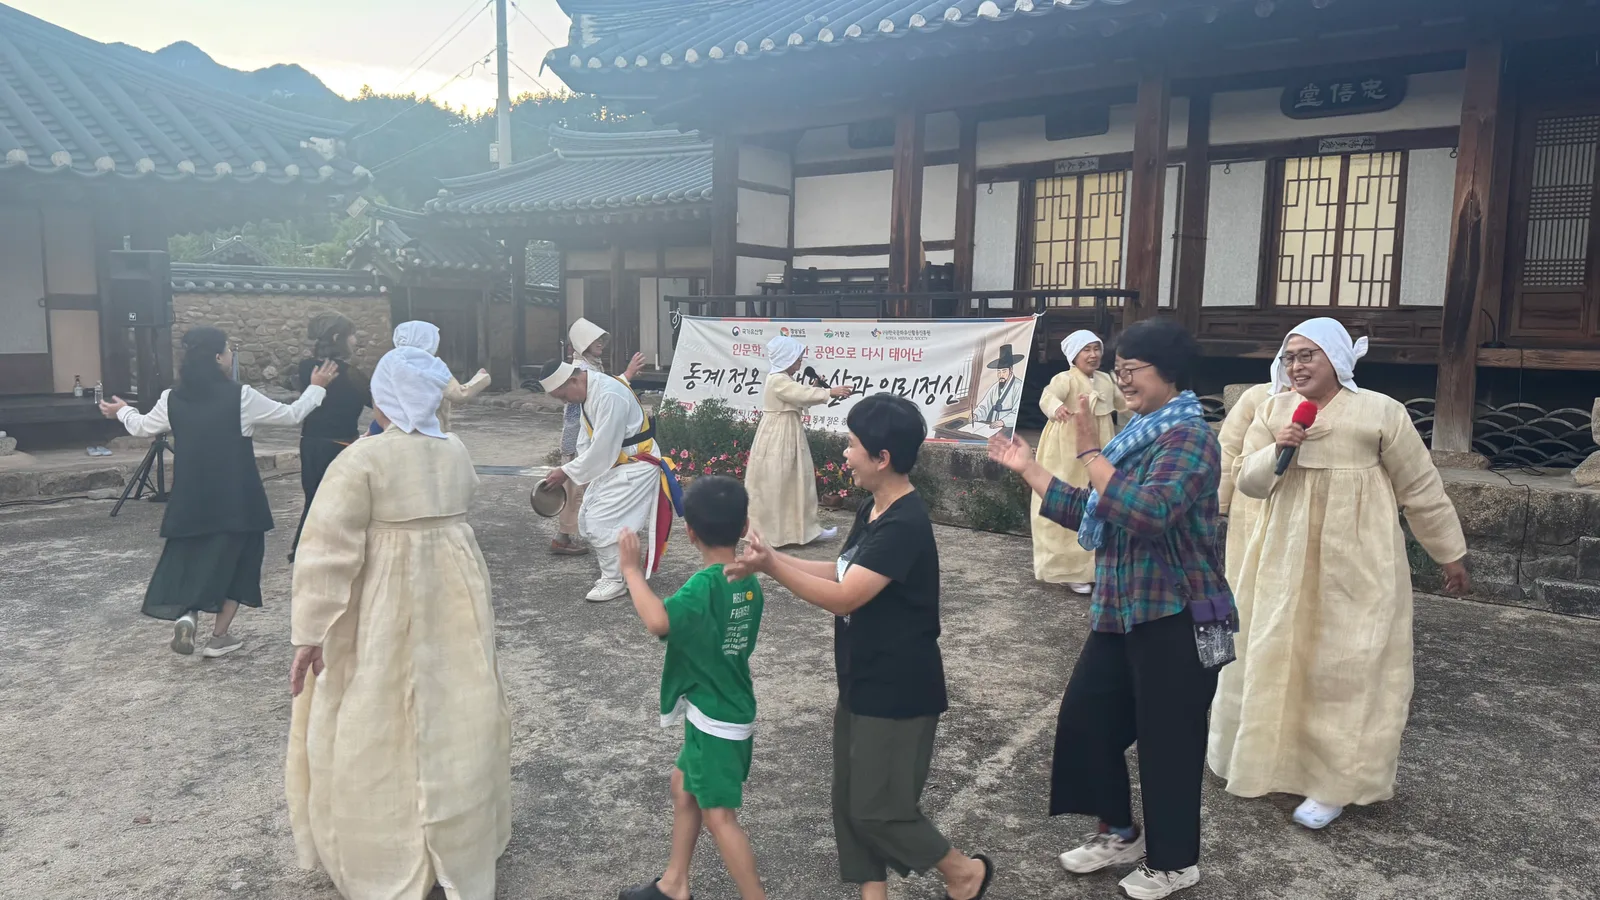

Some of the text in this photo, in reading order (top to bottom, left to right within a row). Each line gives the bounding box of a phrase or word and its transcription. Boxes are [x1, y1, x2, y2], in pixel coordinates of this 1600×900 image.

[834, 330, 850, 338] 거창군
[814, 345, 857, 360] 공연으로
[861, 347, 884, 361] 다시
[888, 347, 924, 362] 태어난
[683, 362, 725, 390] 동계
[727, 366, 762, 395] 정온
